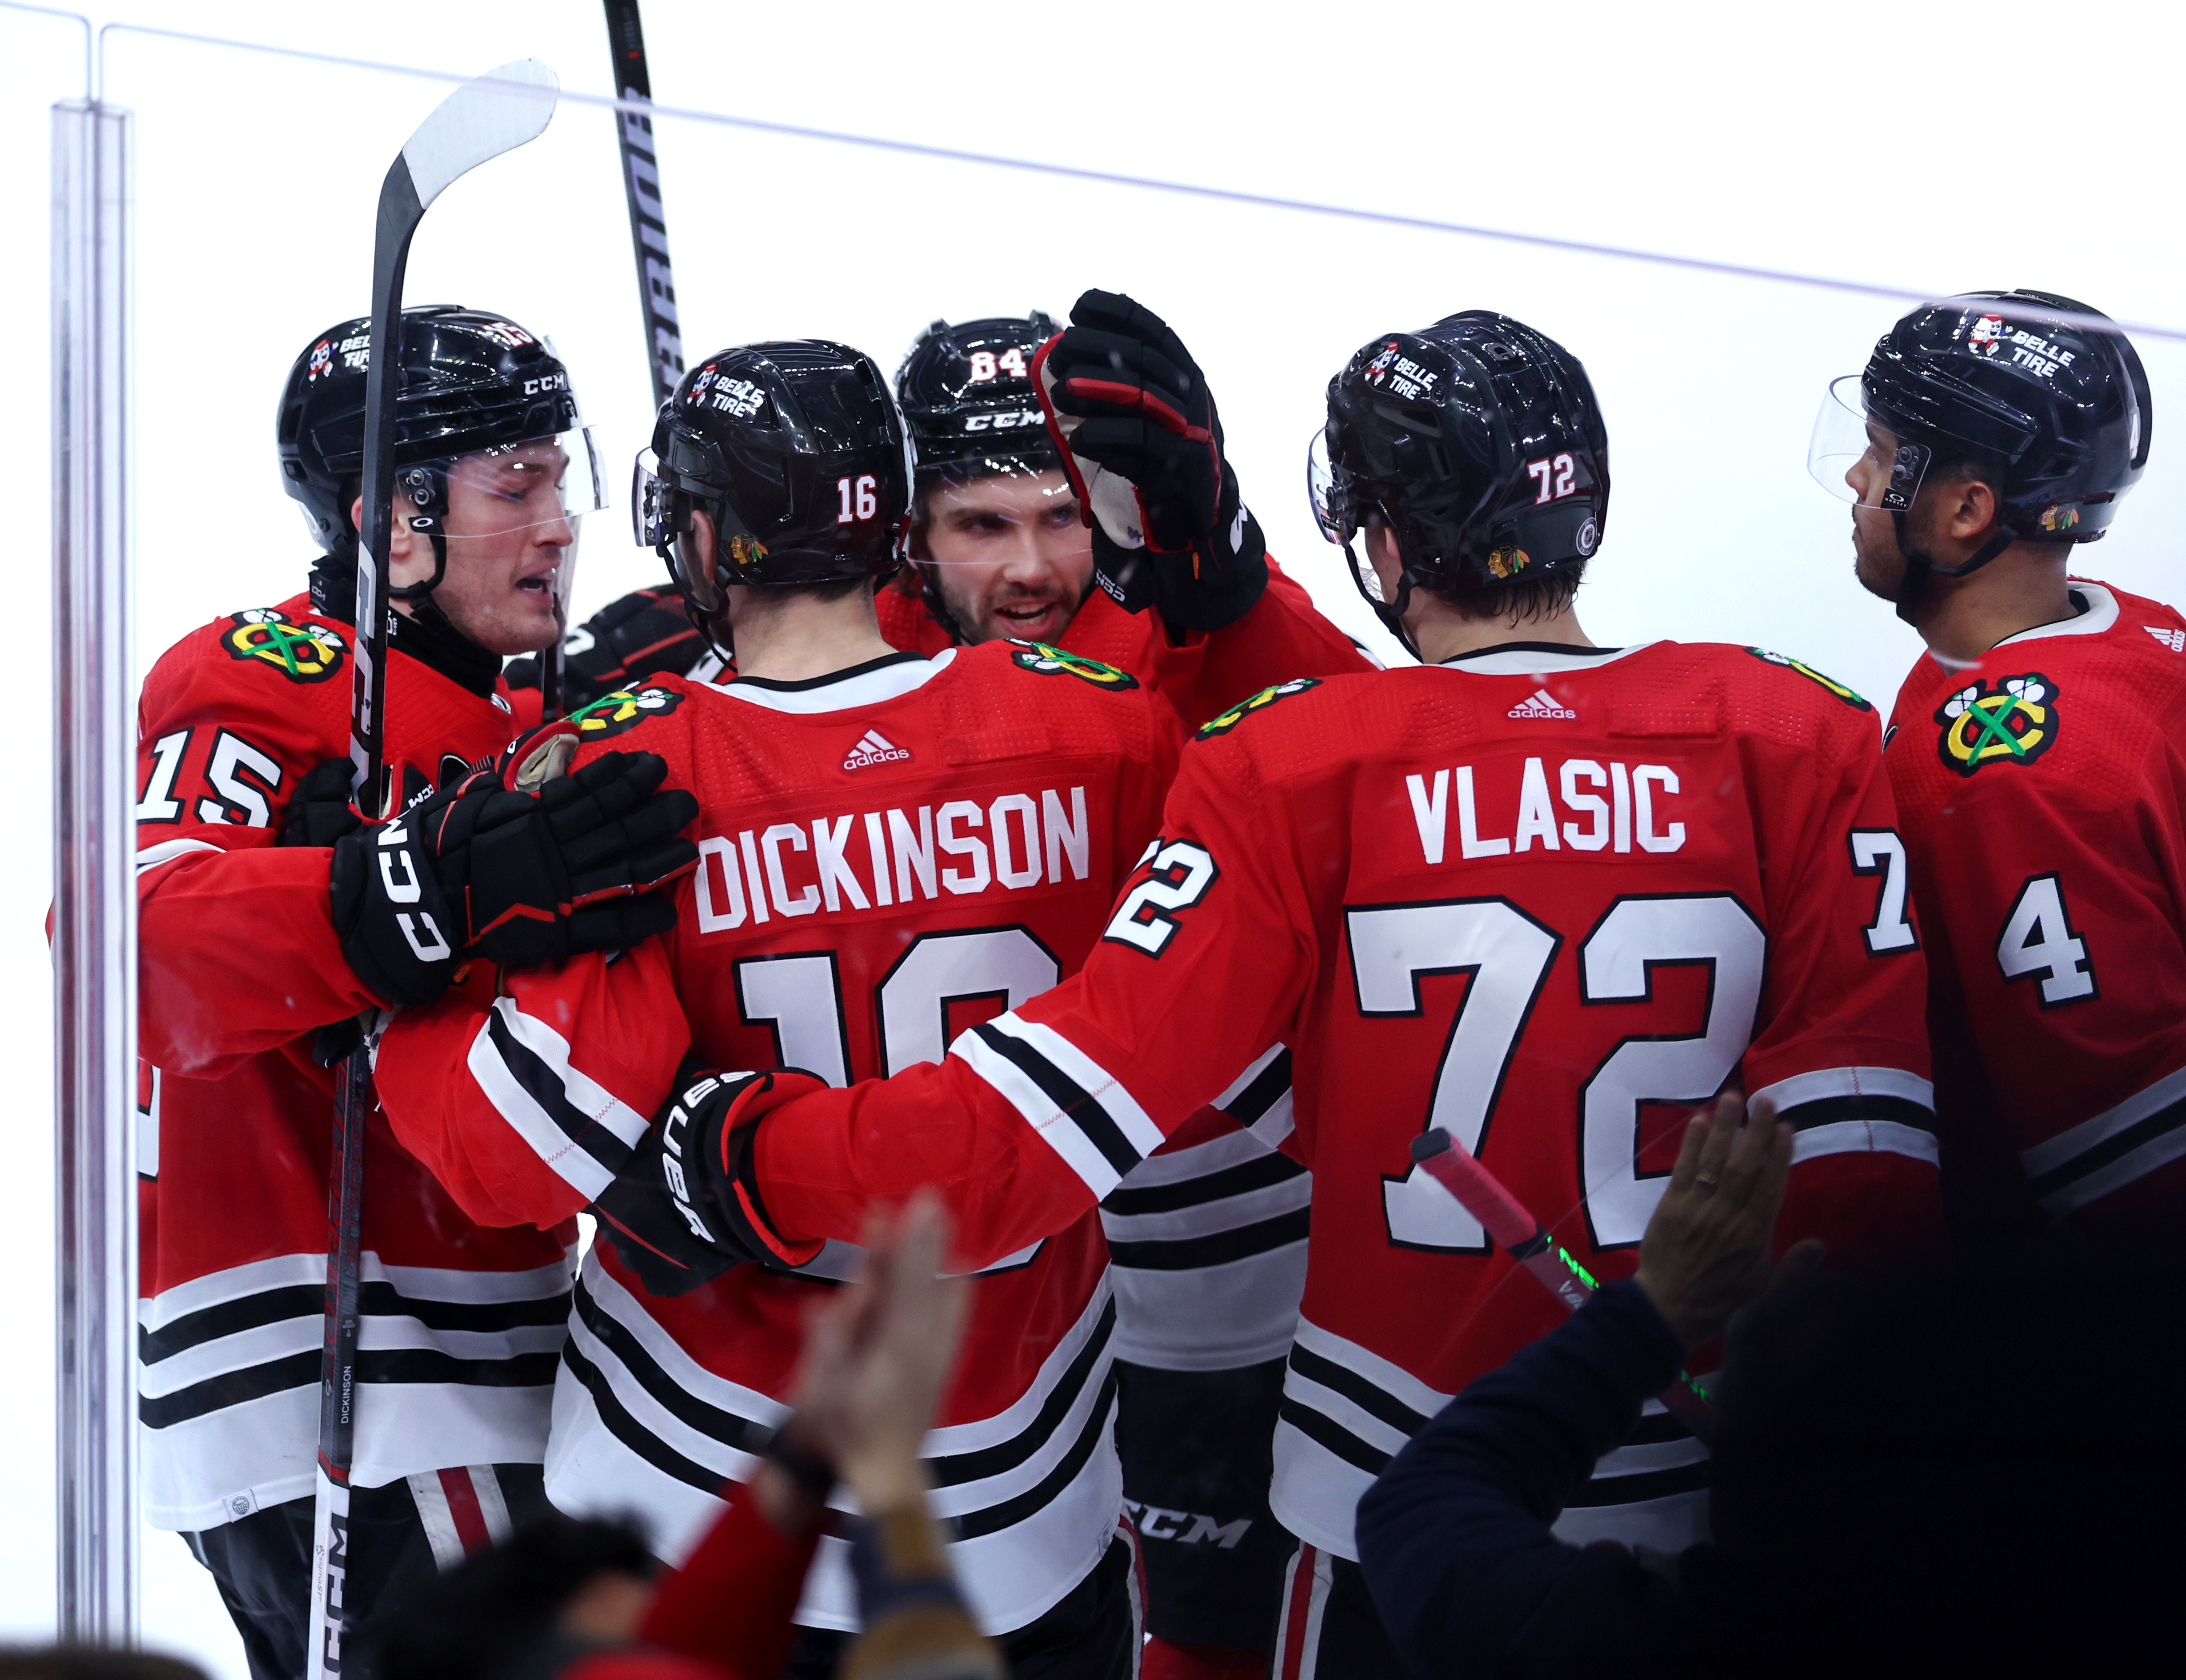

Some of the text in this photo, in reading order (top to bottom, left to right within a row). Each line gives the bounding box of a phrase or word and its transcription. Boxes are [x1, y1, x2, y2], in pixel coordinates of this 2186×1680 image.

[339, 335, 371, 353] BEL
[344, 349, 370, 367] TIR
[2012, 329, 2076, 367] BELLE
[970, 348, 1028, 381] 84
[1394, 357, 1438, 391] BELLE
[2011, 348, 2060, 378] TIRE
[523, 373, 567, 396] CCM
[715, 376, 766, 409] BELLE
[1389, 374, 1421, 400] TIRE
[711, 393, 748, 418] TIRE
[964, 410, 1047, 431] CCM
[1527, 452, 1577, 505] 72
[836, 474, 877, 524] 16
[1096, 572, 1125, 602] CCM
[2171, 629, 2186, 653] adidas
[1507, 706, 1576, 719] adidas
[843, 746, 910, 770] adidas
[137, 726, 284, 829] 15
[408, 784, 435, 809] CCM
[1405, 756, 1687, 864] VLASIC
[695, 785, 1090, 935] DICKINSON
[377, 809, 452, 963] CCM
[1994, 871, 2101, 1011] 4
[1343, 890, 1770, 1255] 72
[340, 1365, 352, 1424] DICKINSON
[324, 1512, 349, 1674] CCM
